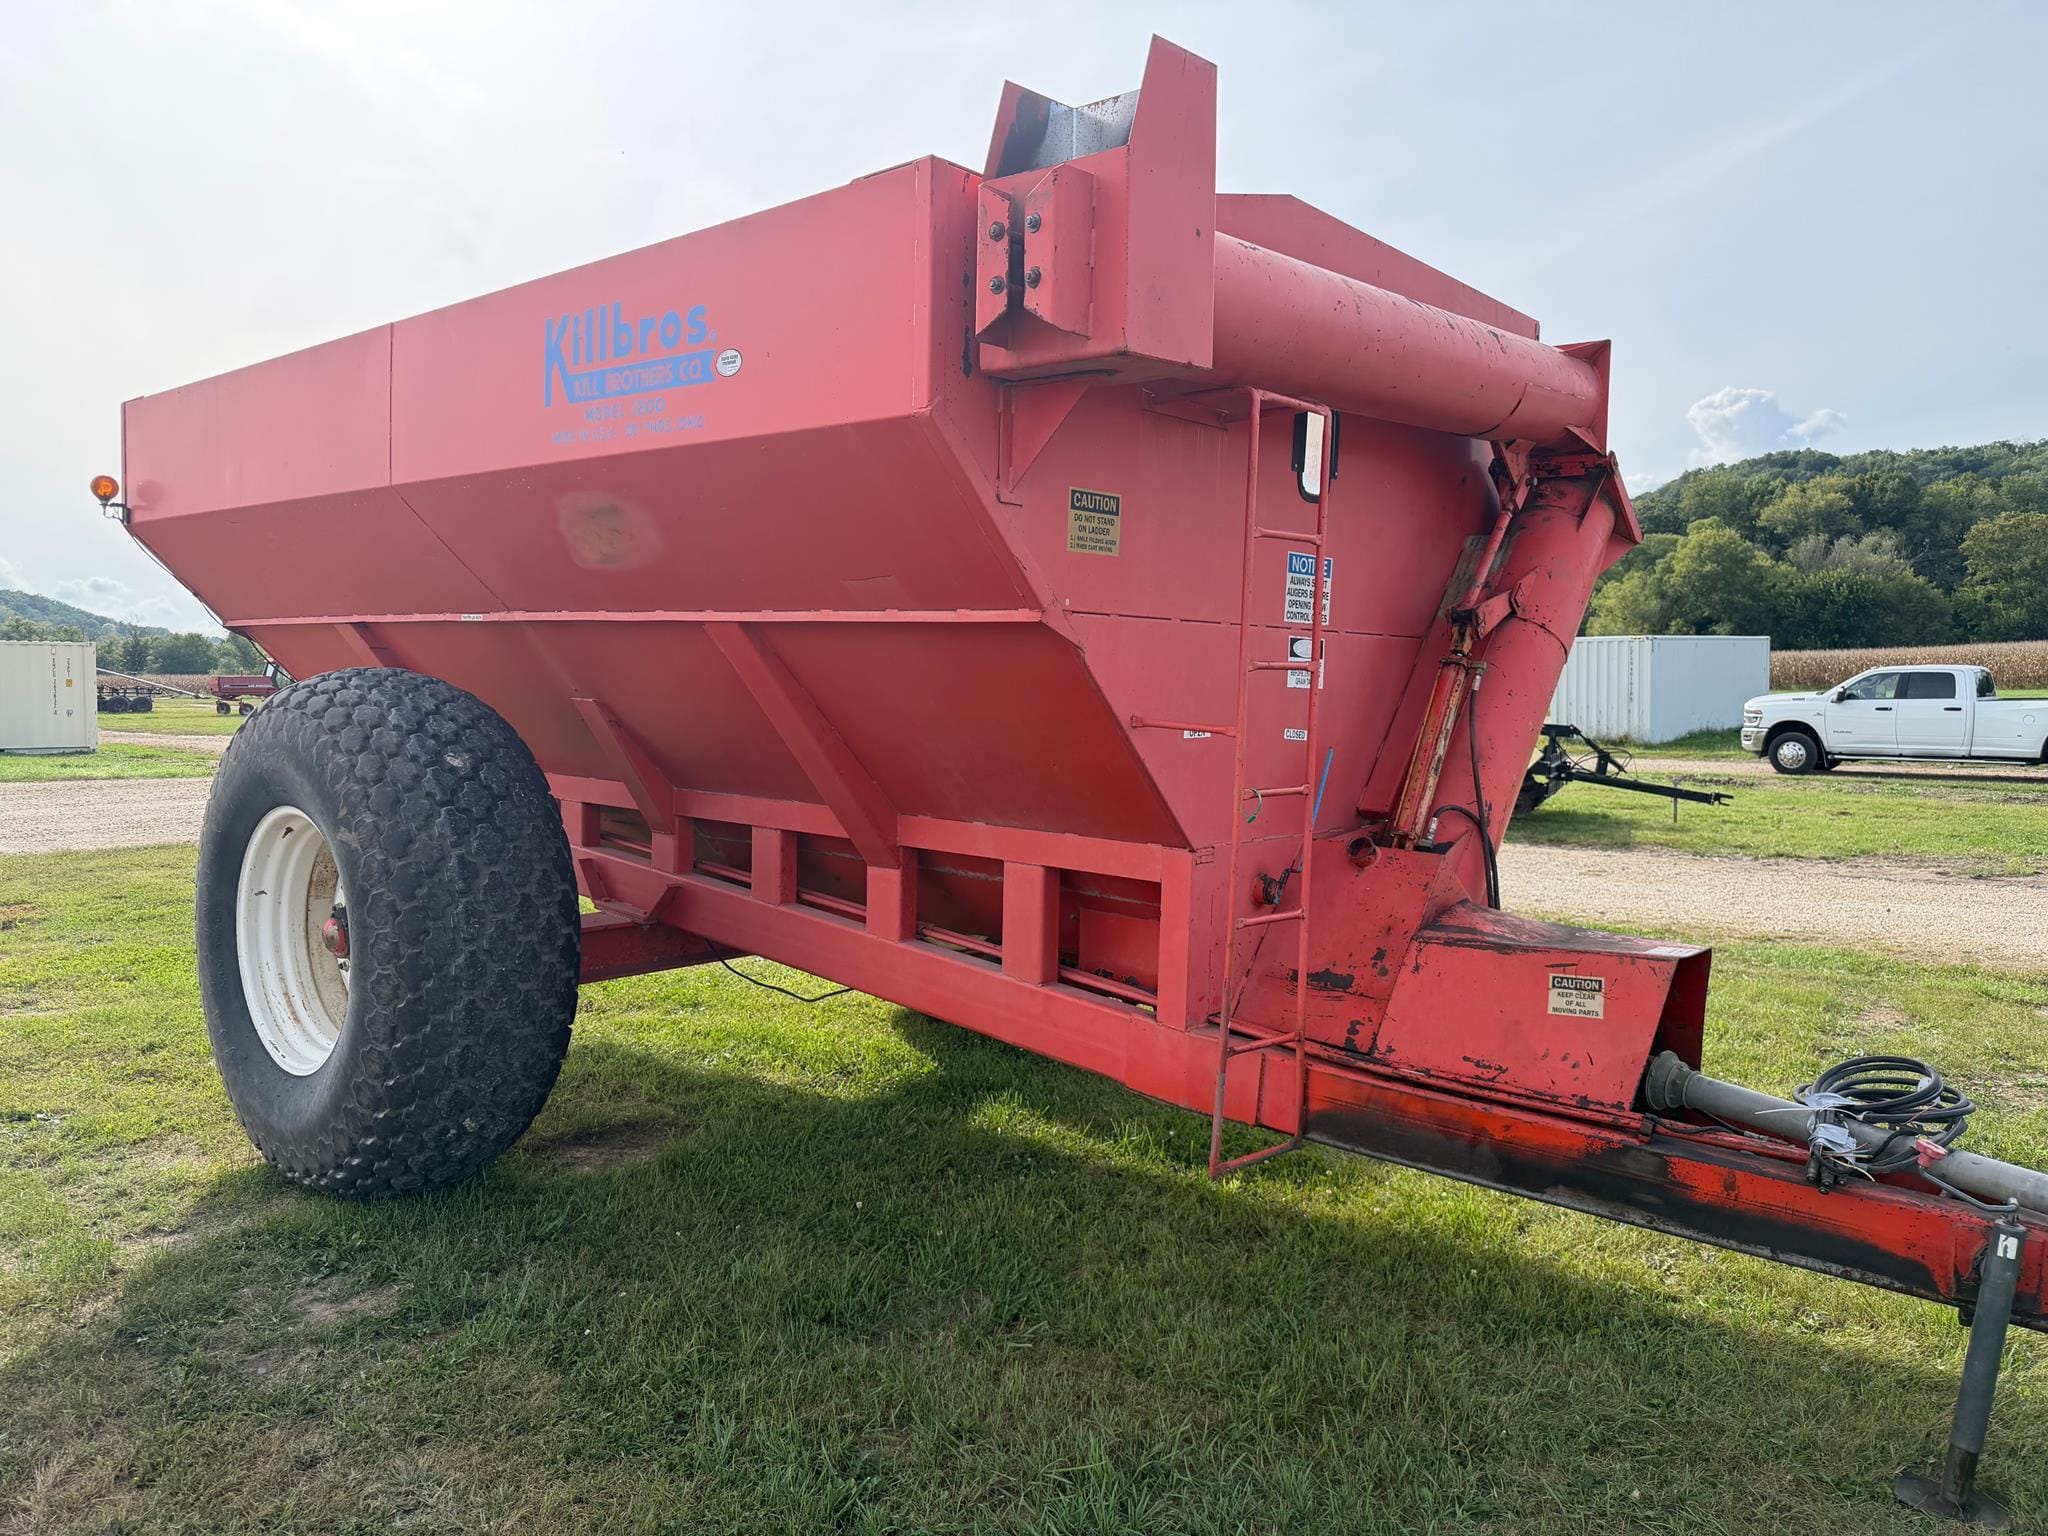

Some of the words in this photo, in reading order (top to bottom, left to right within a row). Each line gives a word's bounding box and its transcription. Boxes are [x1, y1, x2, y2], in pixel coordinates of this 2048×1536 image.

[574, 374, 599, 397] KILL
[606, 362, 673, 393] BROTHERS
[1074, 492, 1117, 512] CAUTION
[1074, 513, 1083, 522] DO
[1084, 515, 1096, 524] NOT
[1097, 516, 1115, 527] STAND
[1078, 524, 1087, 533] ON
[1088, 526, 1111, 536] LADDER
[1292, 556, 1328, 576] NOTIE
[1290, 576, 1311, 587] ALWAYS
[1287, 587, 1308, 599] AUGERS
[1288, 599, 1311, 610] OPENING
[1286, 610, 1310, 622] CONTROL
[1285, 729, 1306, 740] CLOSED
[1554, 977, 1599, 990] CAUTION
[1552, 1006, 1577, 1014] MOVING
[1579, 1009, 1599, 1017] PARTS
